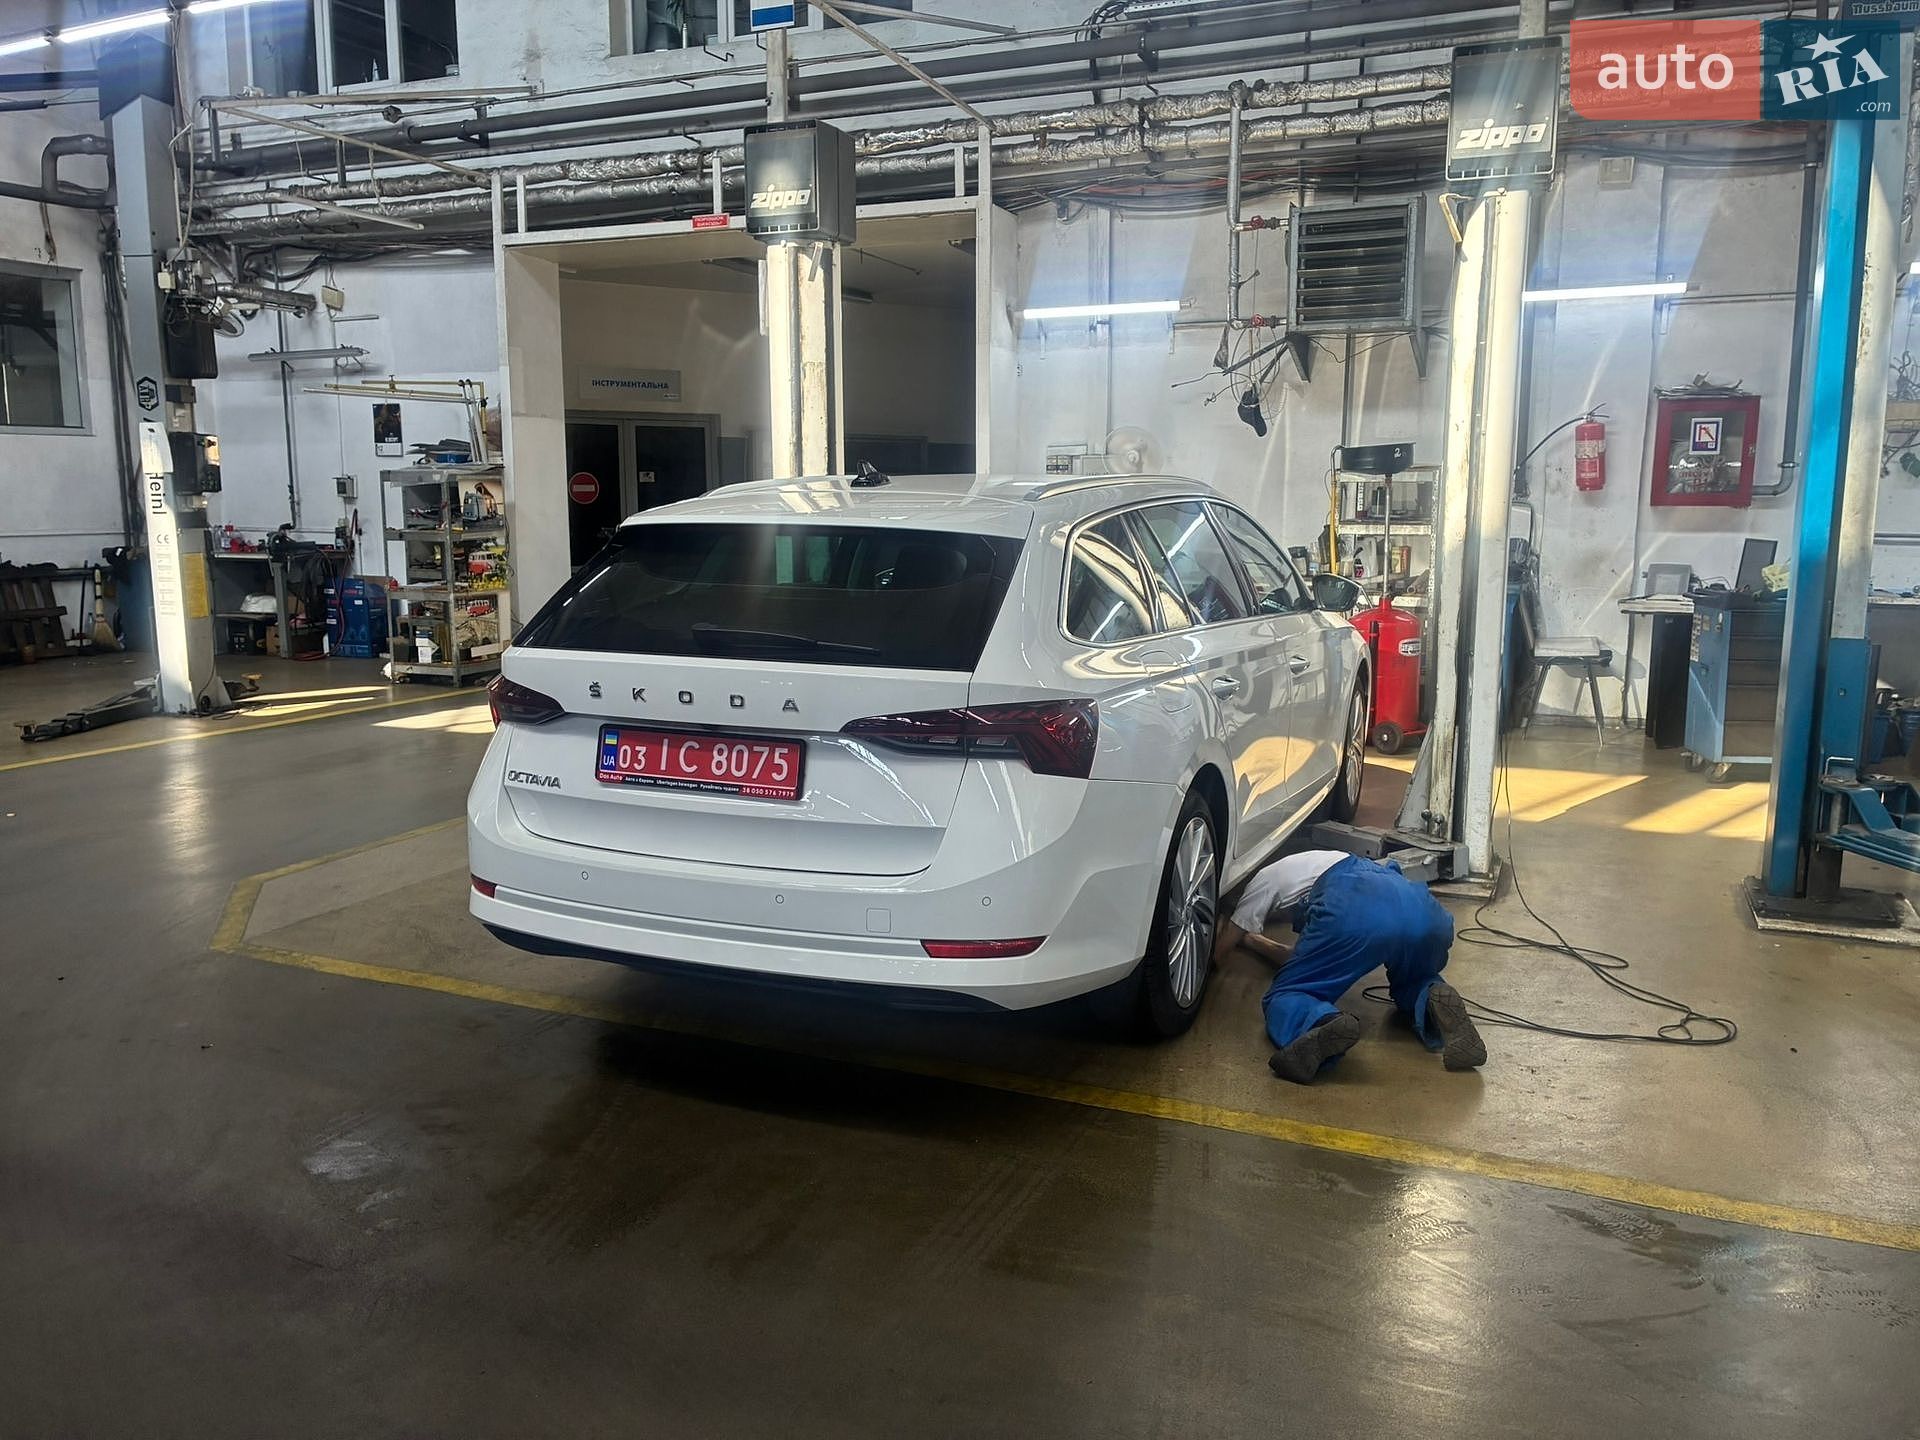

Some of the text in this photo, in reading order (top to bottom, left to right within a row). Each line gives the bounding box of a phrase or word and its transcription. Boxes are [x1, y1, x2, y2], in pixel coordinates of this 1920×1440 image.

[1455, 118, 1547, 150] zippo
[750, 183, 811, 210] zippo
[592, 379, 669, 390] ІНСТРУМЕНТАЛЬНА
[588, 681, 800, 713] ŠKODA
[603, 755, 615, 766] UA
[619, 744, 647, 770] 03
[711, 743, 789, 781] 8075
[508, 770, 561, 789] OCTAVIA
